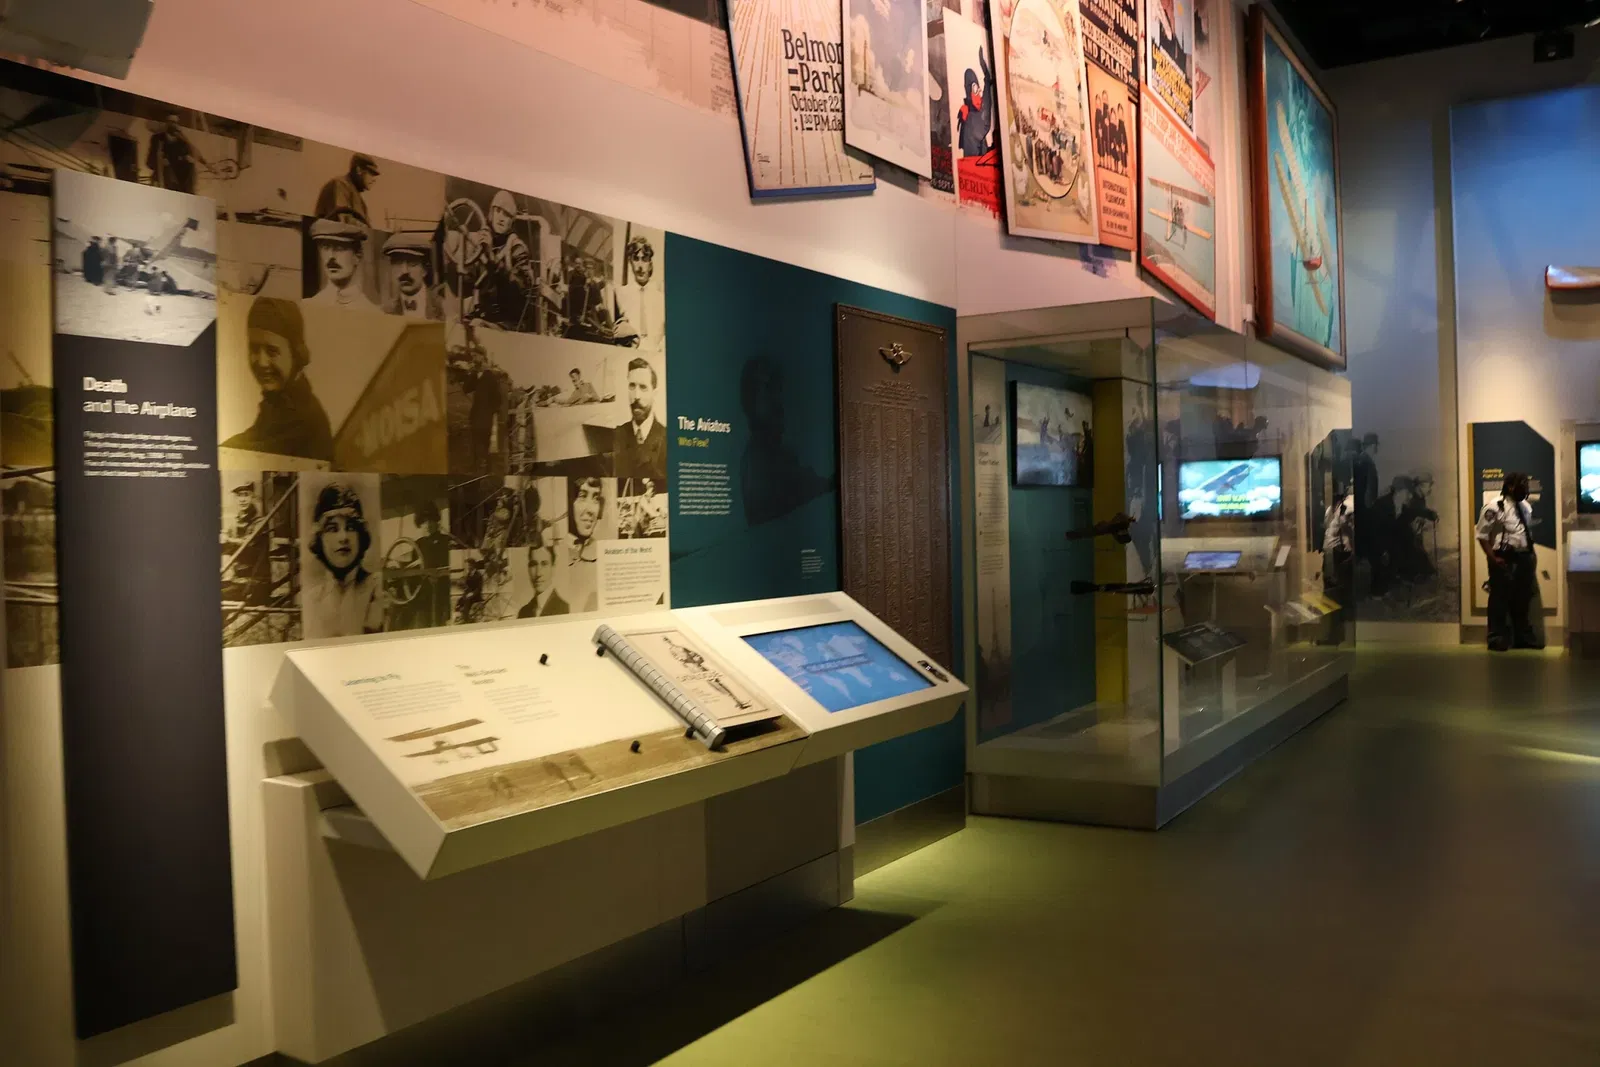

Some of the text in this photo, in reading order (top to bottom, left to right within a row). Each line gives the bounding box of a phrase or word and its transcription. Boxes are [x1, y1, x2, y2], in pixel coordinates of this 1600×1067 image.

[1100, 48, 1128, 84] PALAIS
[799, 62, 843, 94] Park
[791, 93, 827, 112] October
[83, 376, 128, 393] Death
[83, 399, 197, 419] and the Airplane
[677, 415, 731, 433] The Aviators
